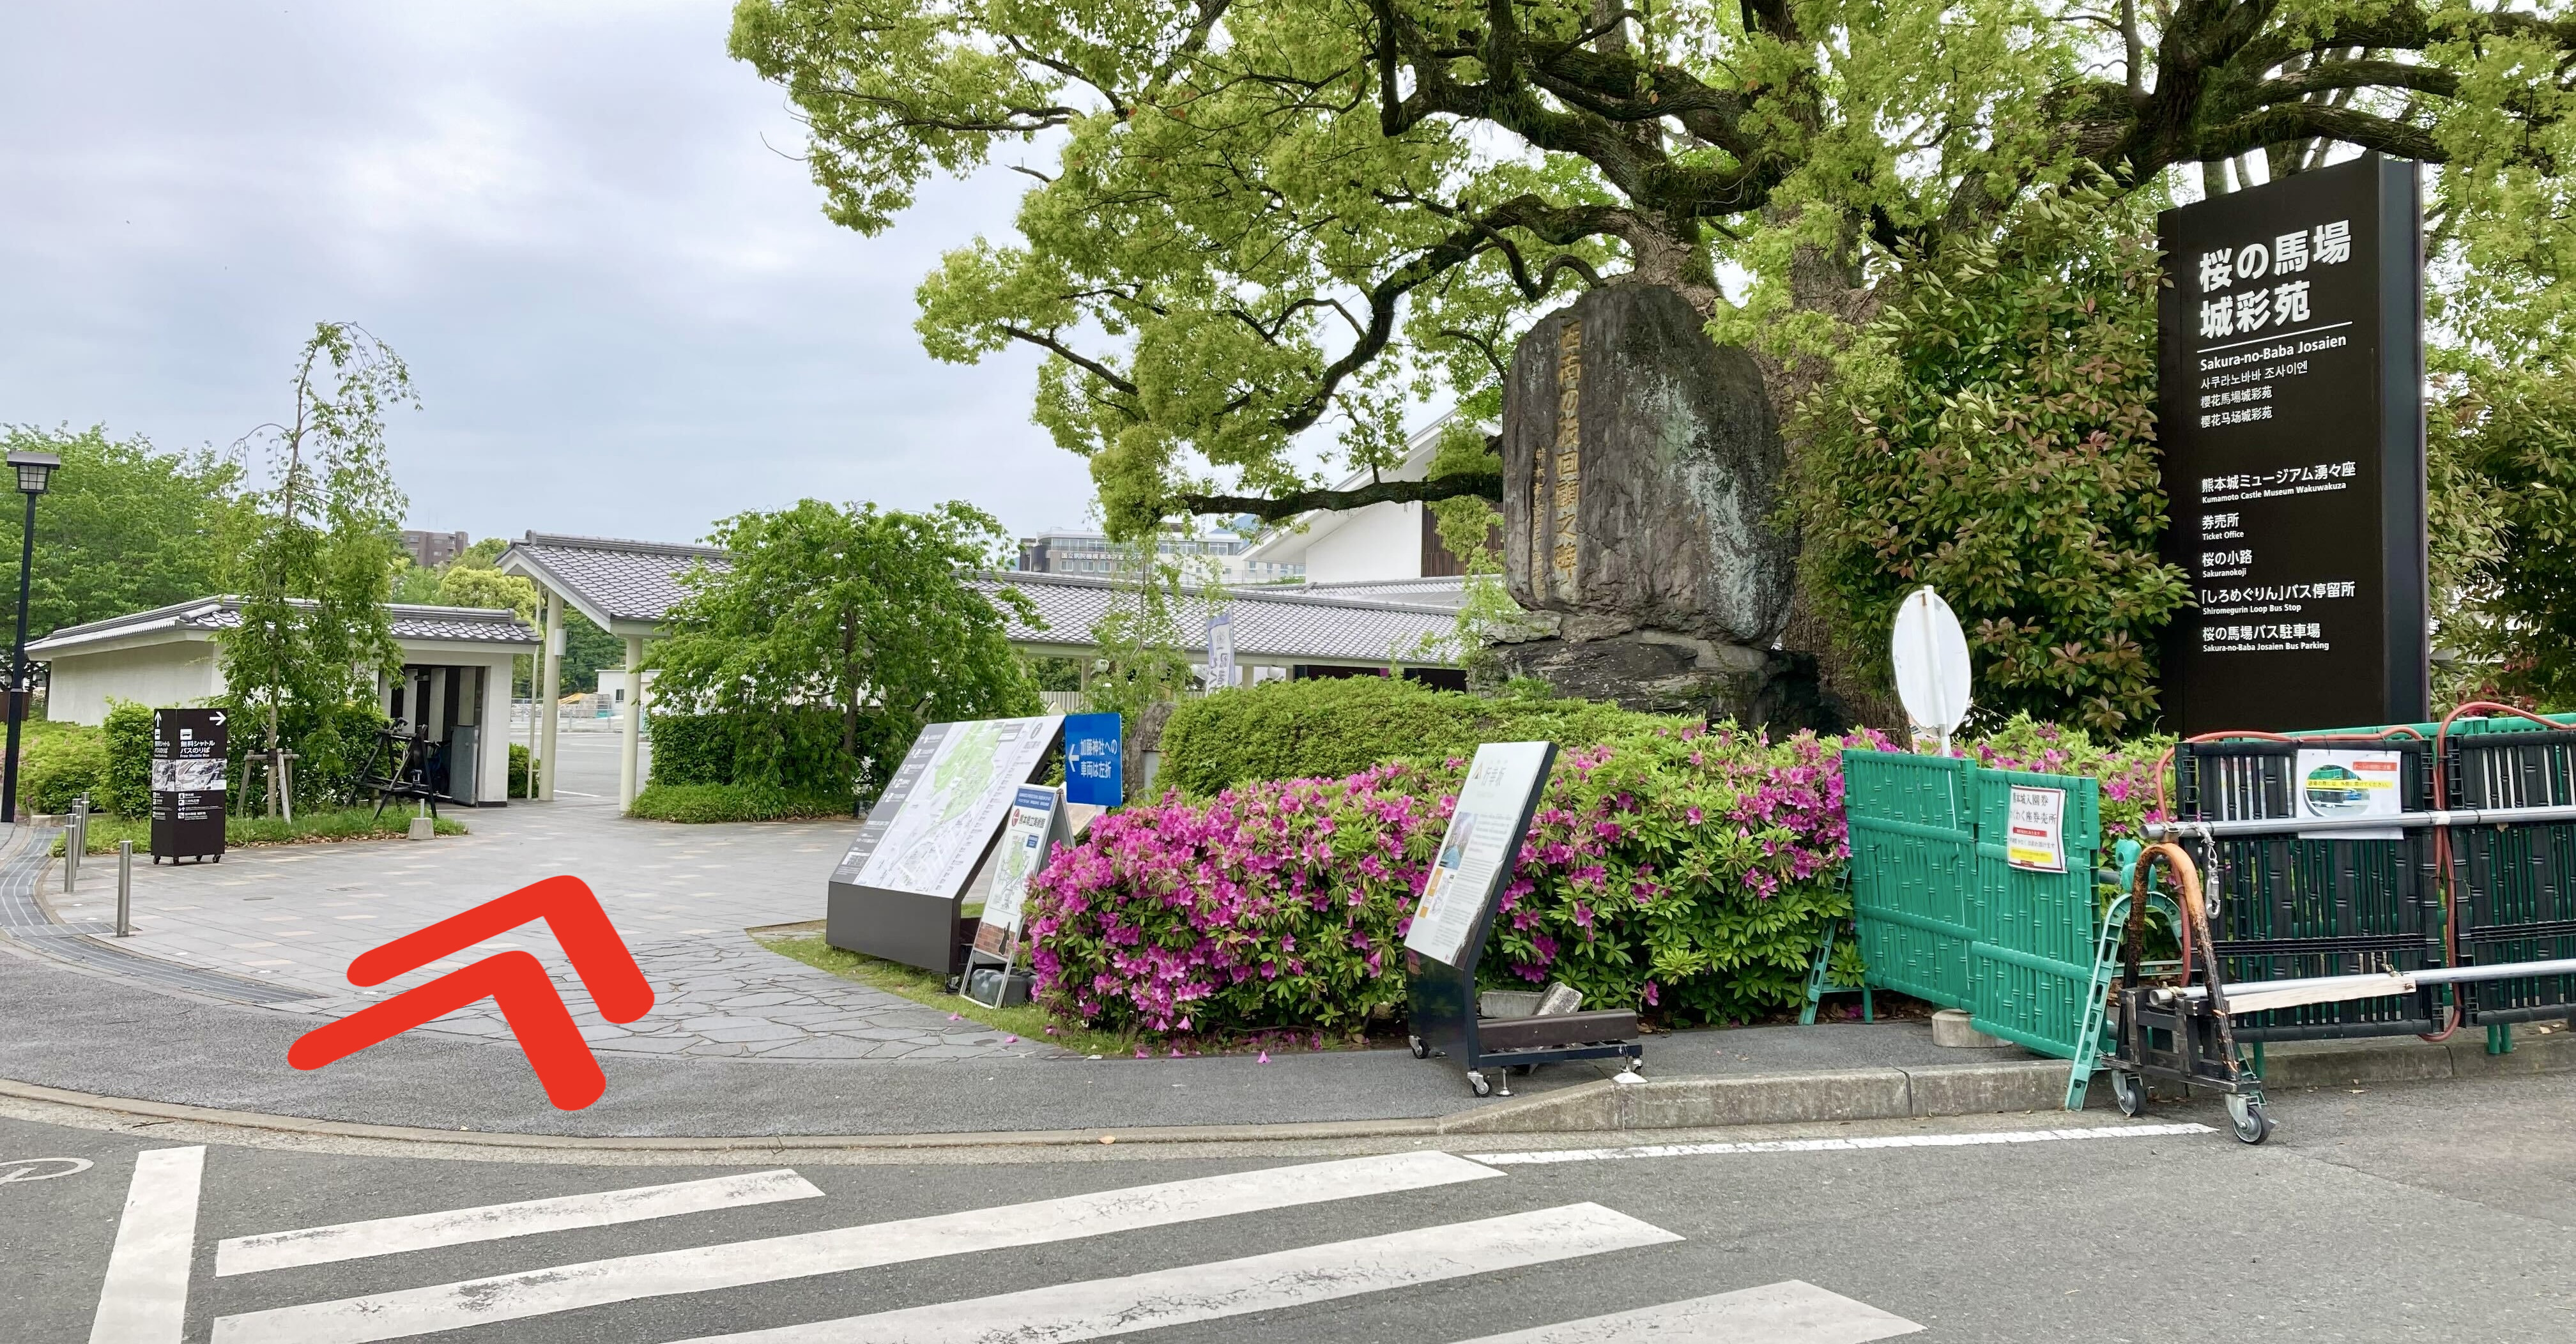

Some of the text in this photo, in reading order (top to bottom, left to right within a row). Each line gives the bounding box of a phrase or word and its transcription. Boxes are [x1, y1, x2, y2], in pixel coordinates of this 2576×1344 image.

[2199, 220, 2351, 293] 桜の馬場
[2200, 280, 2311, 339] 城彩苑
[2200, 334, 2346, 371] Sakura-no-Baba Josaien
[2200, 360, 2308, 390] 사쿠라노바바 조사이엔
[2200, 385, 2273, 409] 櫻花馬場城彩苑
[2202, 461, 2356, 493] 熊本城ミュージアム湧々座
[2202, 482, 2346, 504] Kumamoto Castle Museum Wakuwakuza
[2202, 512, 2239, 530] 券売所
[2202, 530, 2244, 540] Ticket Office
[2202, 549, 2252, 567] 桜の小路
[2203, 568, 2247, 578] Sakuranokoji
[2202, 581, 2356, 605] 「しろめぐりん」バス停留所
[2203, 603, 2301, 615] Shiromegurin Loop Bus Stop
[2203, 623, 2321, 641] 桜の馬場バス駐車場
[2203, 643, 2255, 653] Sakura-no-Baba
[2257, 643, 2283, 651] Josaien
[2301, 641, 2329, 650] Parking
[1080, 738, 1117, 756] 加藤神社への
[1080, 760, 1112, 779] 車両は左折
